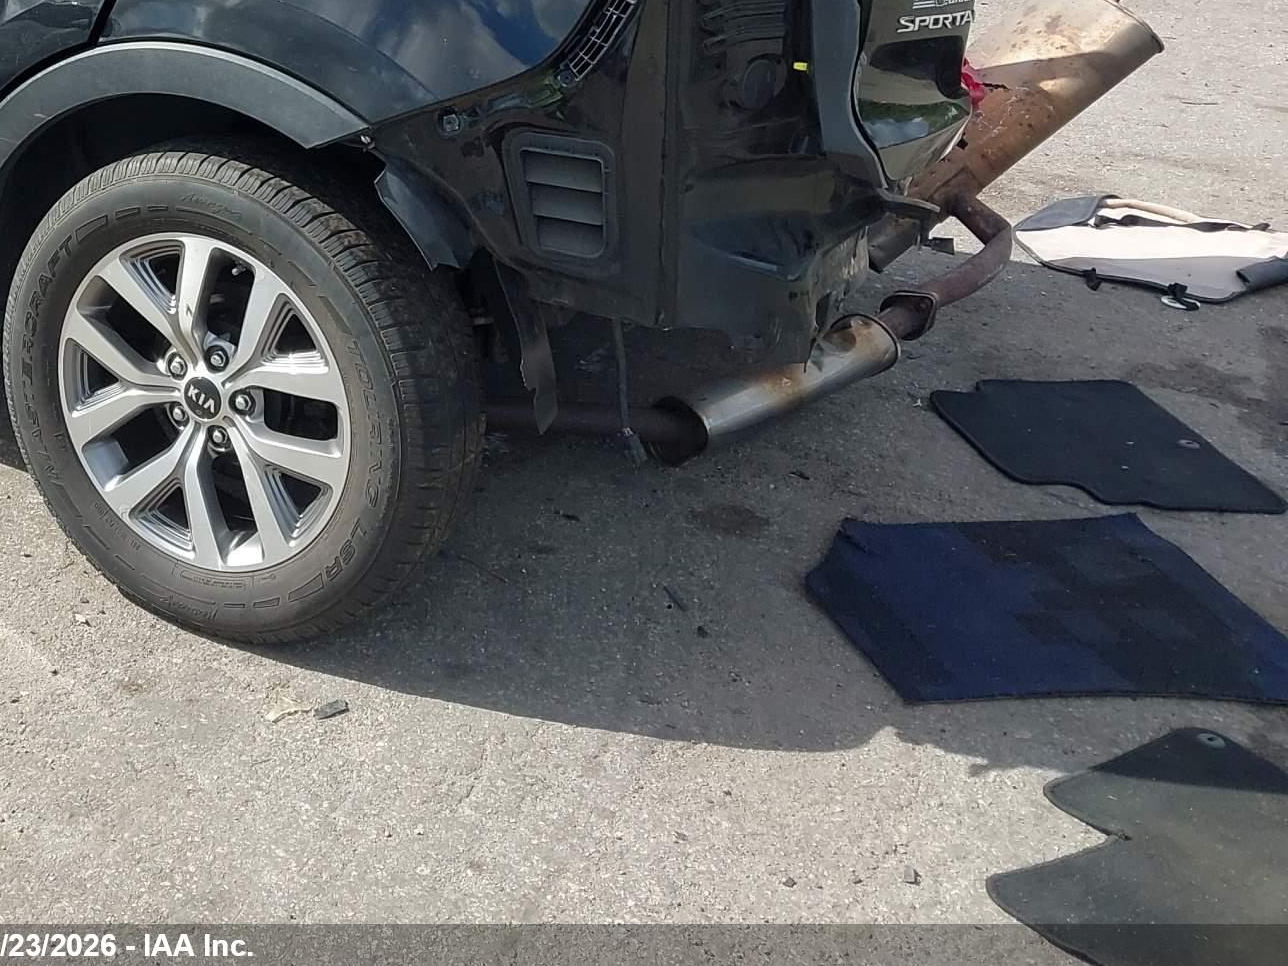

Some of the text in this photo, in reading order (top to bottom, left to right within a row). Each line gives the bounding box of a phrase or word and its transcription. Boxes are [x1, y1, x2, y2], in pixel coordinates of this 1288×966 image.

[187, 384, 215, 414] KIA
[324, 338, 384, 583] TOURING LSR
